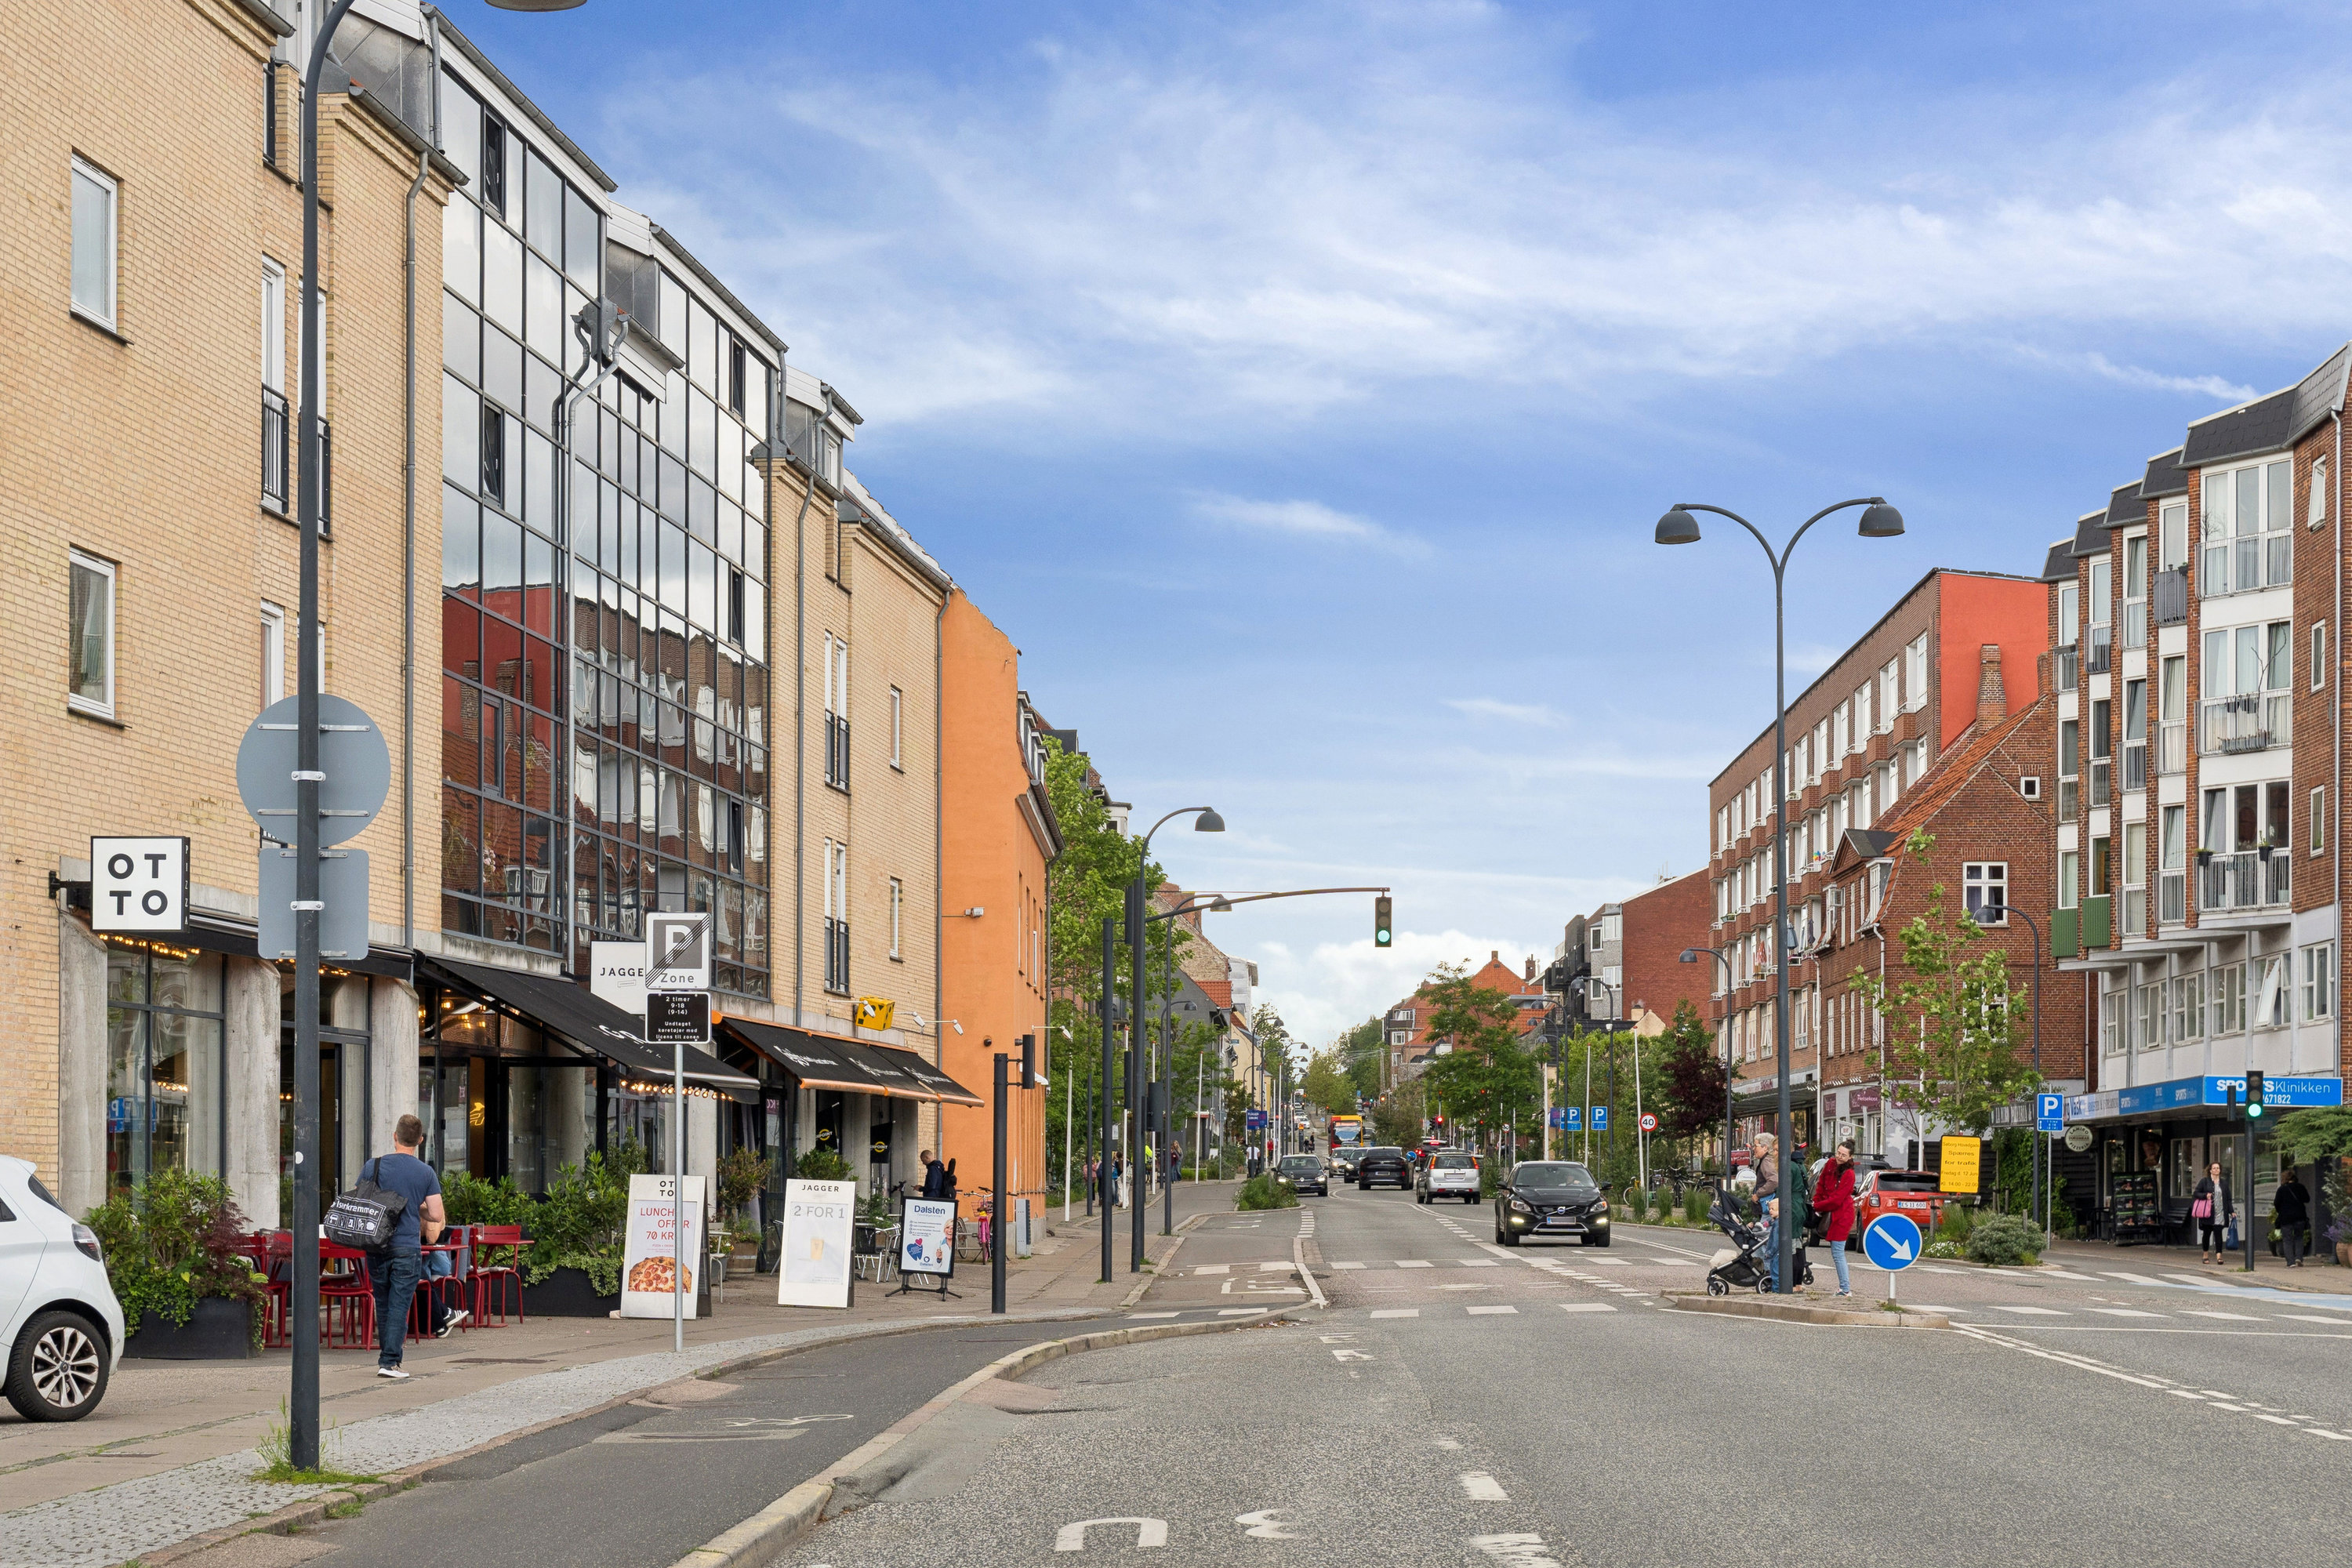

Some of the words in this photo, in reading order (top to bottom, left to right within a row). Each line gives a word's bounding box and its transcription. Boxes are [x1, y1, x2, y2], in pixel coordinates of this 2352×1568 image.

[107, 853, 167, 880] OT
[109, 889, 169, 916] TO
[600, 967, 644, 977] JAGGE
[661, 973, 695, 983] Zone
[2275, 1081, 2331, 1093] Klinikken
[2263, 1094, 2291, 1104] 671822
[2044, 1097, 2059, 1116] P
[1570, 1109, 1577, 1120] P
[1595, 1109, 1604, 1120] P
[640, 1207, 675, 1217] LUNCH
[793, 1205, 801, 1216] 2
[806, 1206, 833, 1218] FOR
[838, 1207, 844, 1218] 1
[914, 1205, 946, 1214] Dalsten
[657, 1219, 690, 1229] OFFR
[646, 1231, 658, 1240] 70
